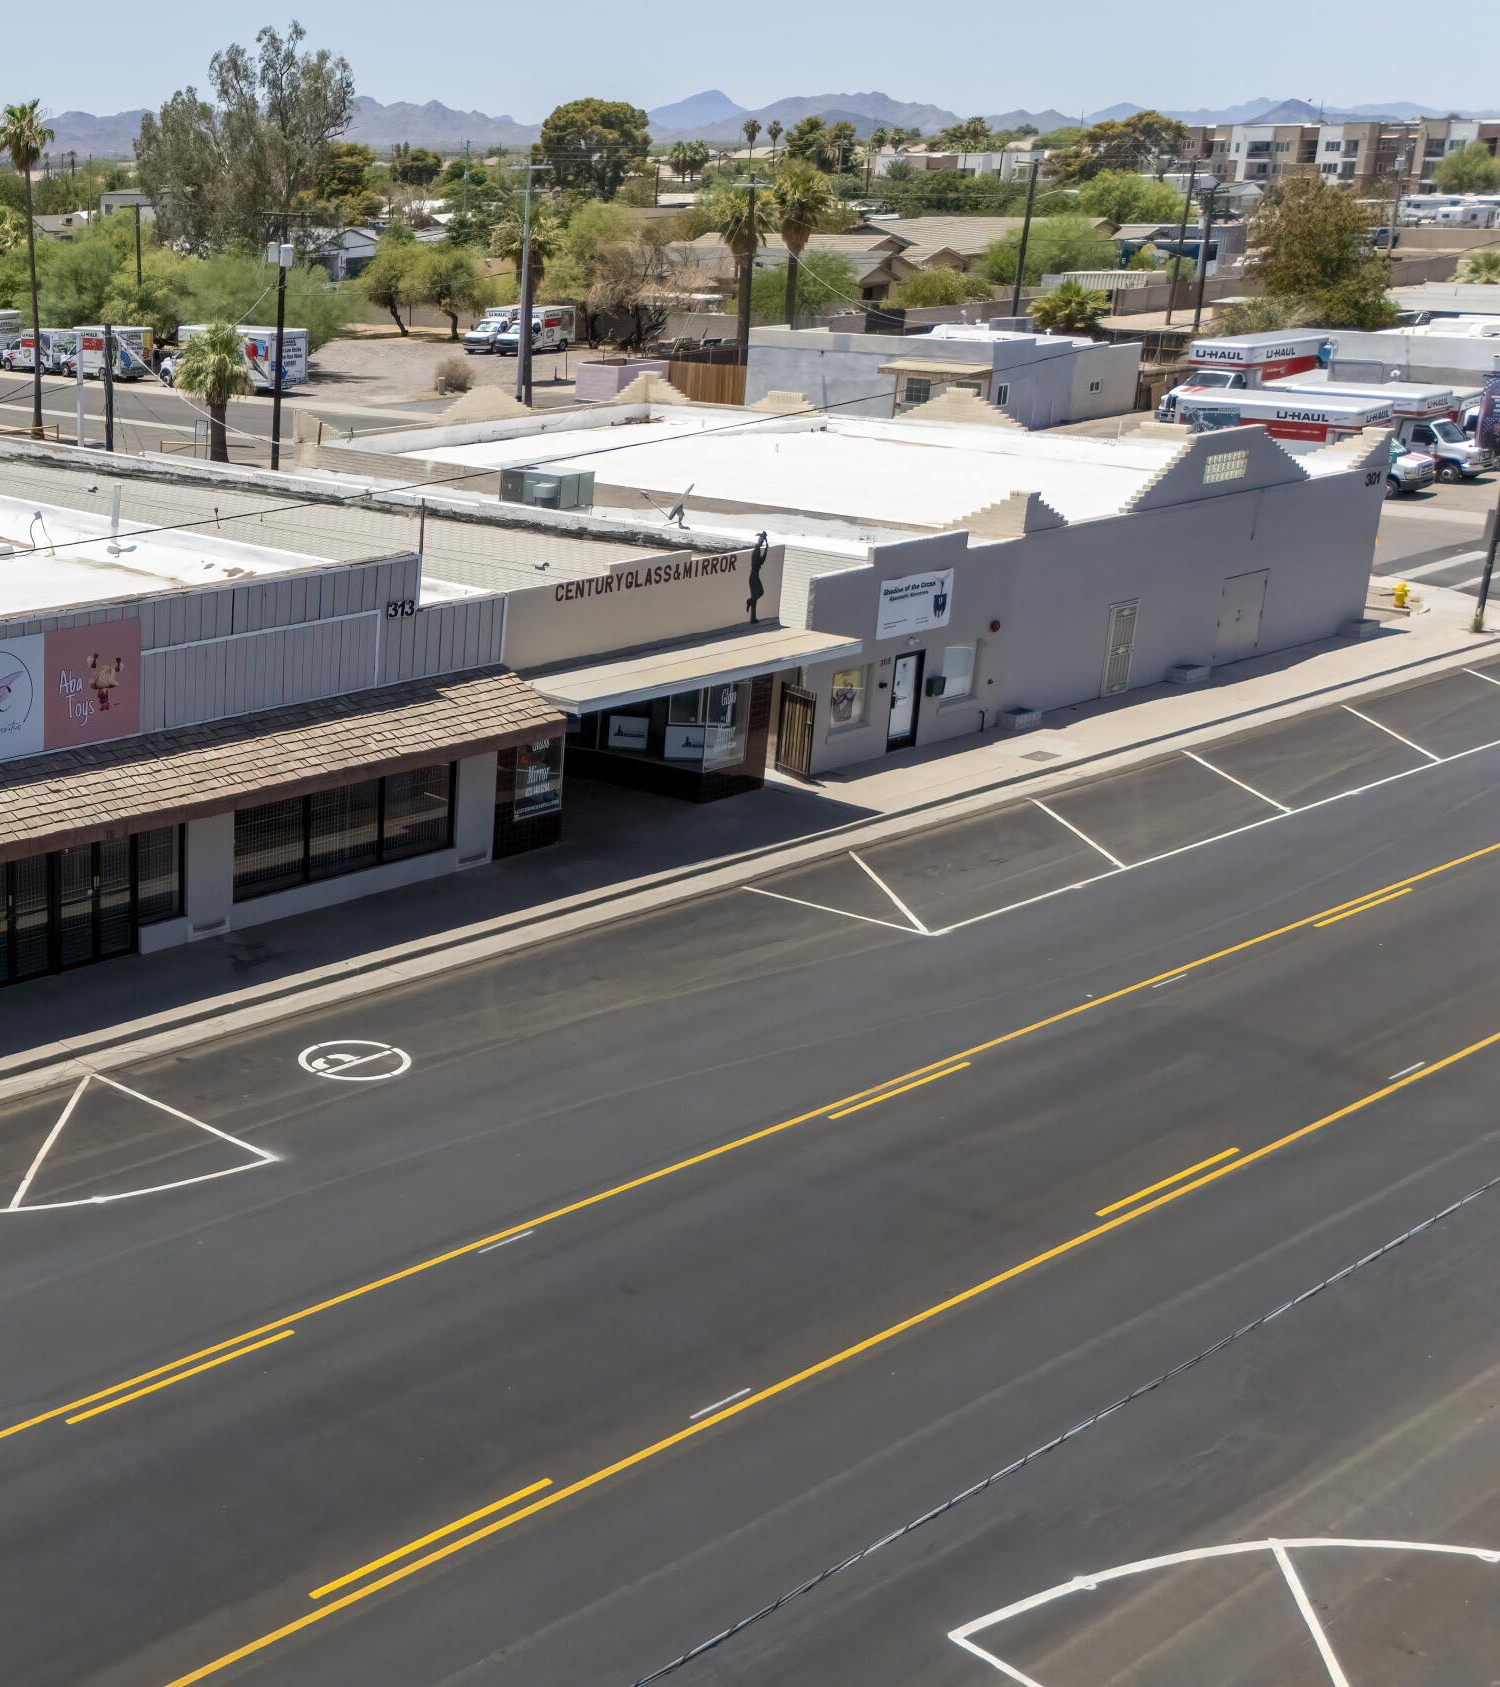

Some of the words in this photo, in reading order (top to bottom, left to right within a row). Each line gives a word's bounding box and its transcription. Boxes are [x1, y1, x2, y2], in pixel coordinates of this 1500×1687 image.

[1195, 349, 1244, 361] U-HAUL
[1266, 347, 1296, 359] U-HAUL
[1276, 410, 1329, 423] U-HAUL
[1366, 410, 1389, 423] U-HAUL
[1365, 471, 1381, 487] 301
[389, 599, 415, 618] 313
[59, 669, 83, 695] Aba
[66, 694, 95, 727] Toys
[527, 766, 550, 784] Mirror
